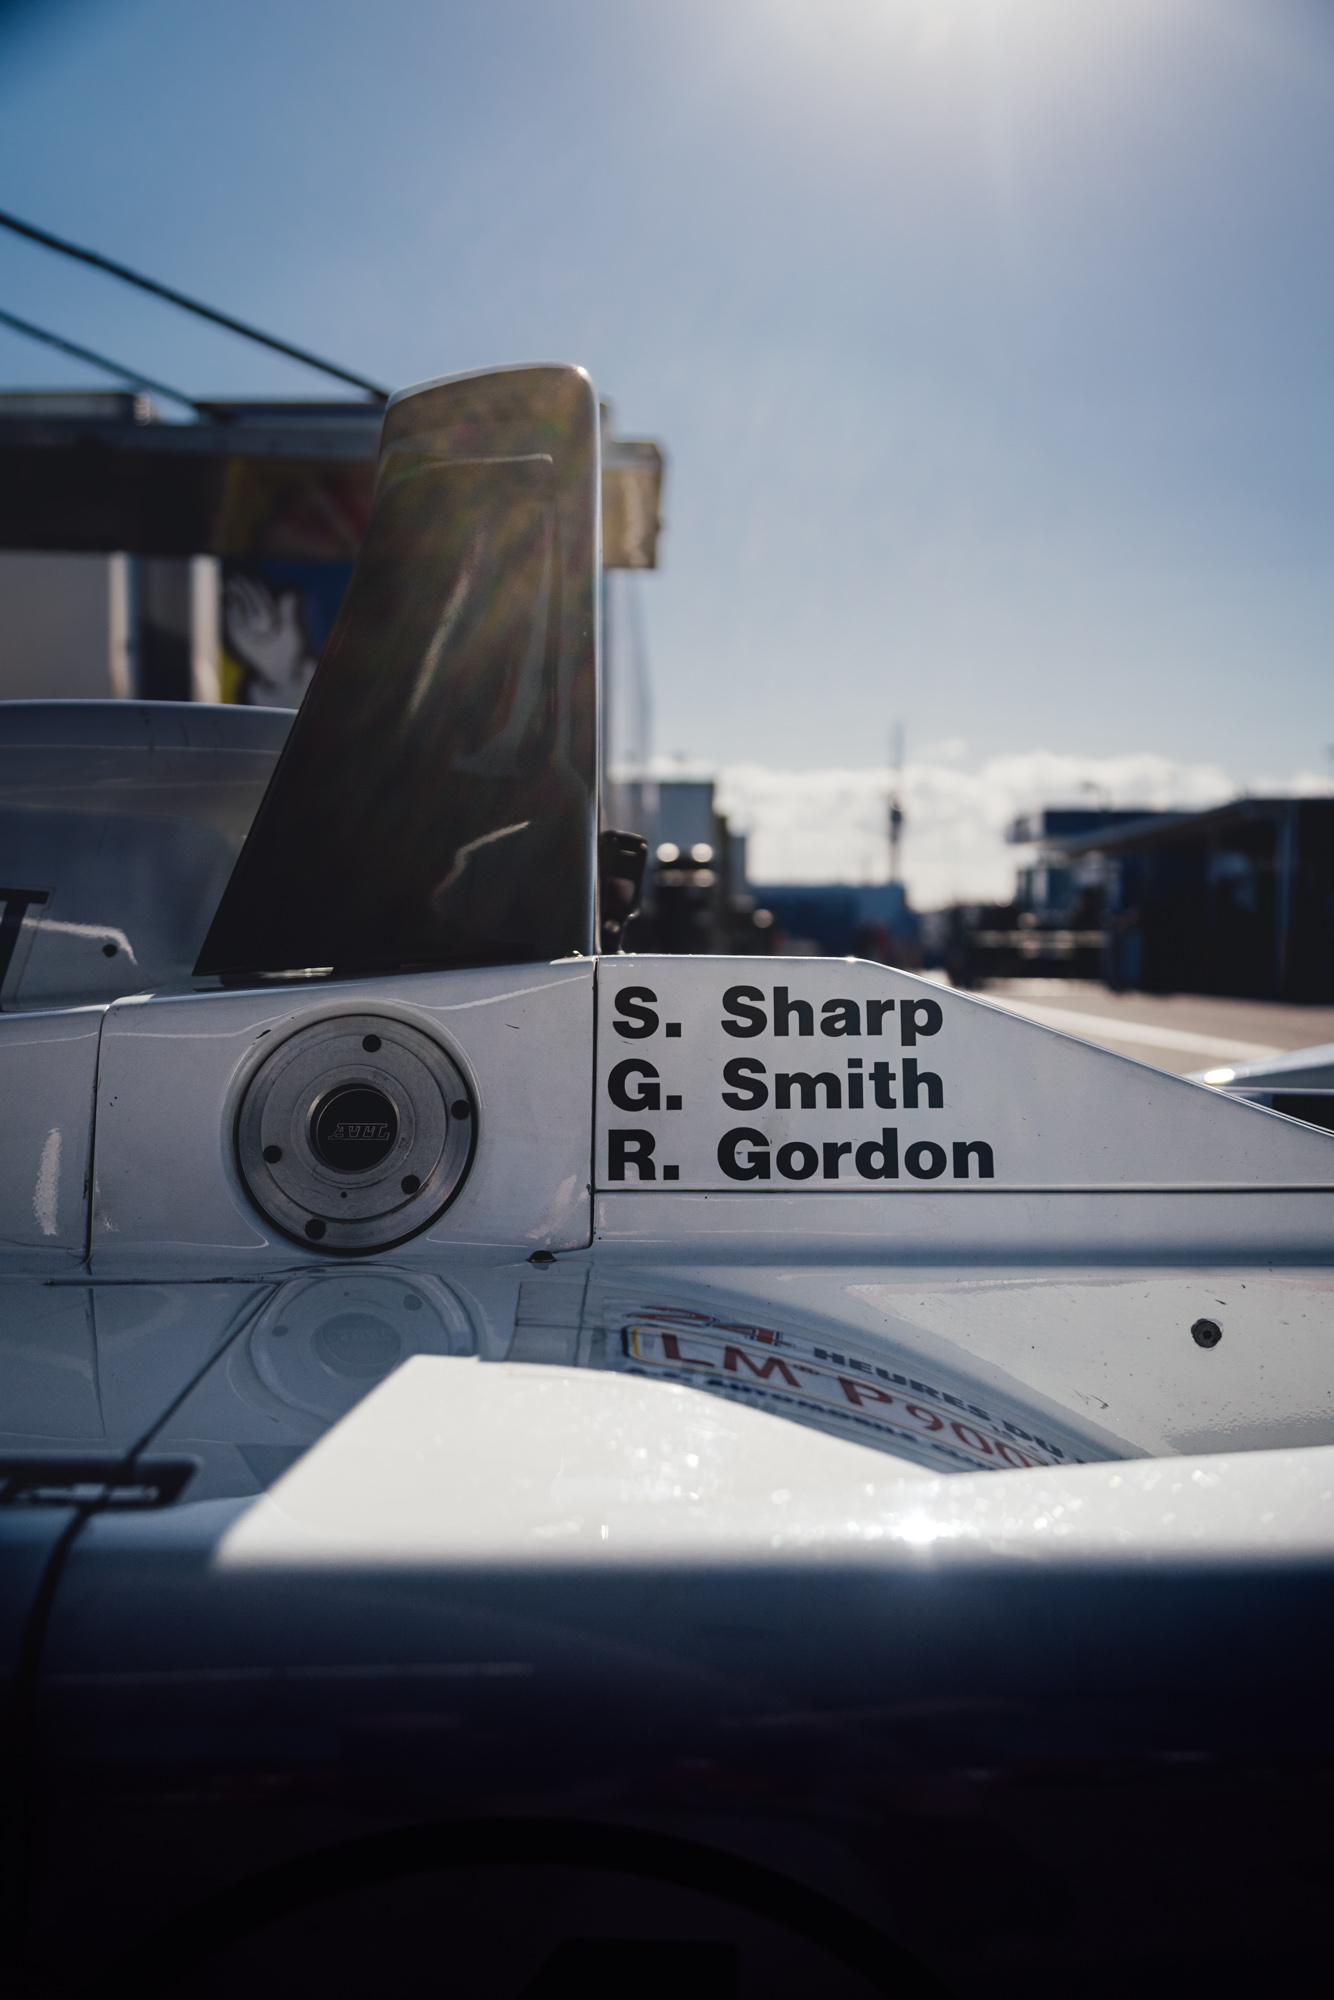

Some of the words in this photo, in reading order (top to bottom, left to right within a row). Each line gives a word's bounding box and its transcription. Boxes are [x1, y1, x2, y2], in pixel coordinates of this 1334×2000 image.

[612, 985, 682, 1039] S.
[720, 985, 944, 1046] Sharp
[607, 1058, 683, 1112] G.
[721, 1057, 944, 1111] Smith
[607, 1129, 680, 1181] R.
[717, 1127, 995, 1181] Gordon
[622, 1305, 796, 1347] 24
[813, 1347, 991, 1421] HEURES
[1002, 1420, 1064, 1458] DU
[661, 1333, 802, 1388] LM
